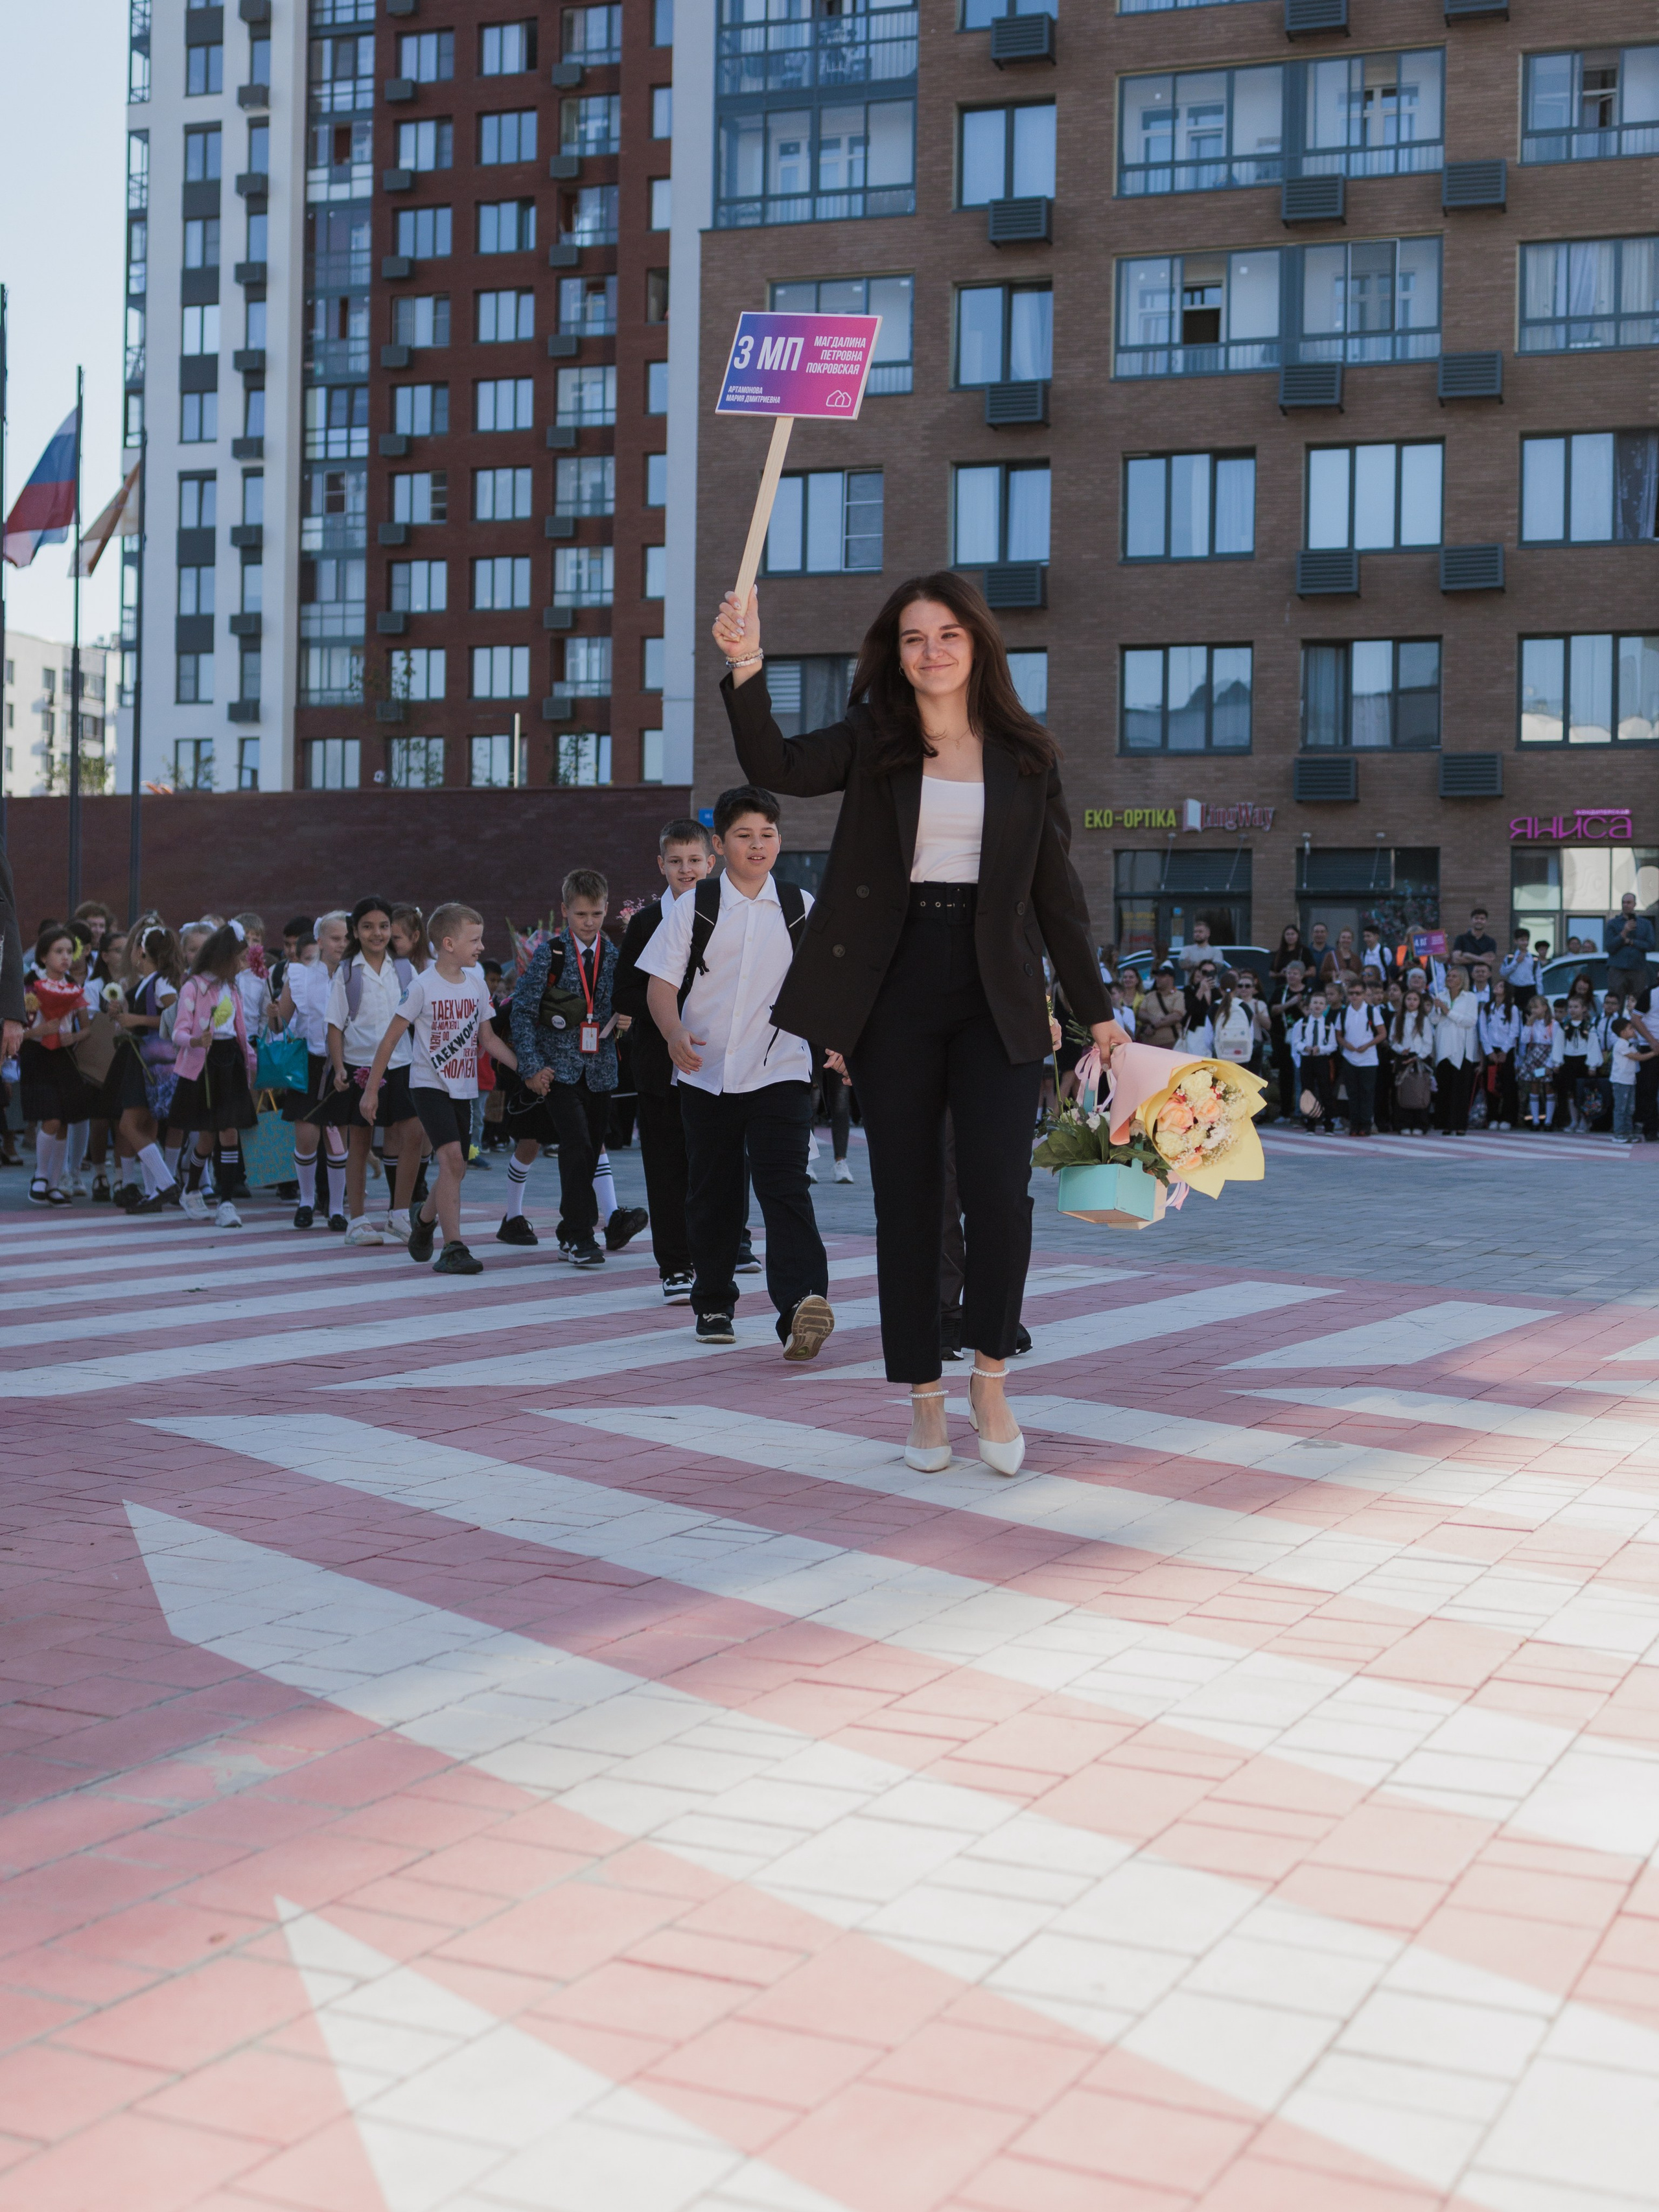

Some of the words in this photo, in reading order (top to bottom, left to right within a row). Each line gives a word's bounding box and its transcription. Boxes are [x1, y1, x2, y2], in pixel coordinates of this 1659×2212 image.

[814, 336, 866, 349] МАГДАЛИНА
[734, 335, 754, 369] 3
[756, 336, 805, 371] МП
[820, 349, 863, 362] ПЕТРОВНА
[806, 362, 860, 375] ПОКРОВСКАЯ
[728, 386, 763, 395] АРТАМОНОВА
[744, 395, 780, 404] ДМИТРИЕВНА
[1200, 802, 1275, 832] LingWay
[432, 999, 479, 1021] TAEKWON-
